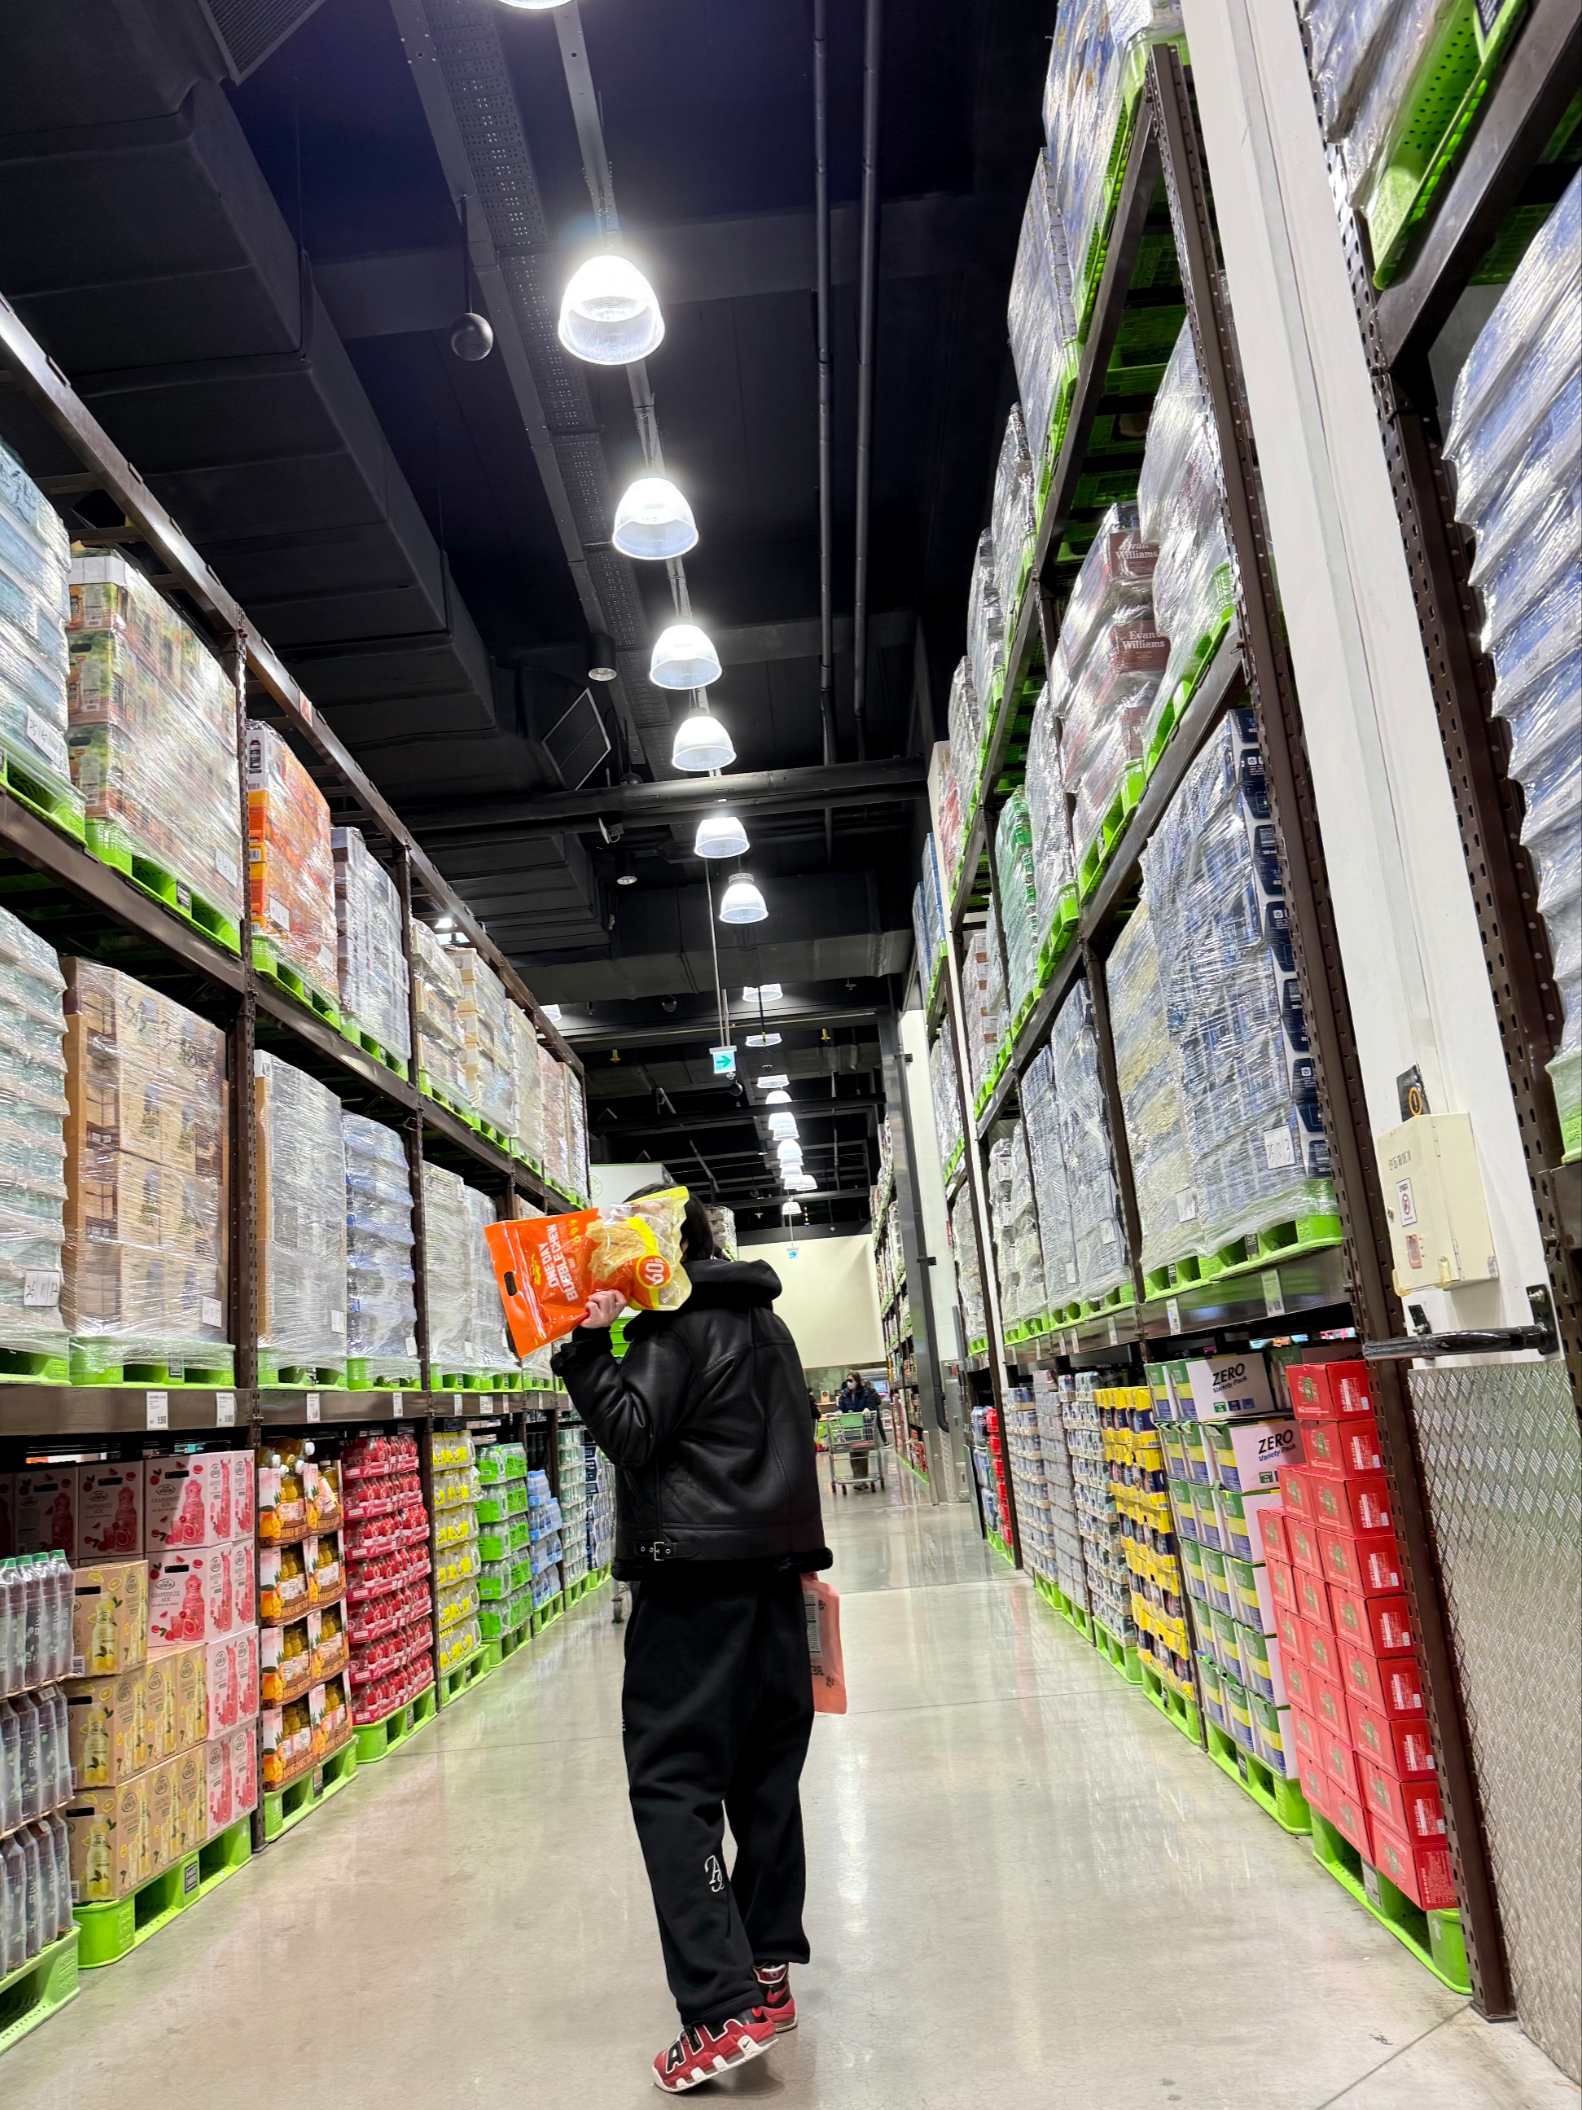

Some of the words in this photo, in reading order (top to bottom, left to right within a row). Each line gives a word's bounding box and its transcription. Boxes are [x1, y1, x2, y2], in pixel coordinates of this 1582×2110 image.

[1115, 550, 1159, 560] Williams
[1121, 639, 1166, 650] Williams
[1129, 630, 1156, 640] Evan
[545, 1223, 562, 1254] CHEW
[538, 1242, 554, 1265] DAY
[544, 1263, 559, 1289] ONE
[552, 1251, 579, 1302] BUBBLE
[1212, 1362, 1245, 1387] ZERO
[1212, 1382, 1233, 1393] Variety
[1233, 1375, 1248, 1386] Pack
[1258, 1429, 1294, 1455] ZERO
[1258, 1449, 1281, 1462] Variety
[1281, 1443, 1297, 1454] Pack
